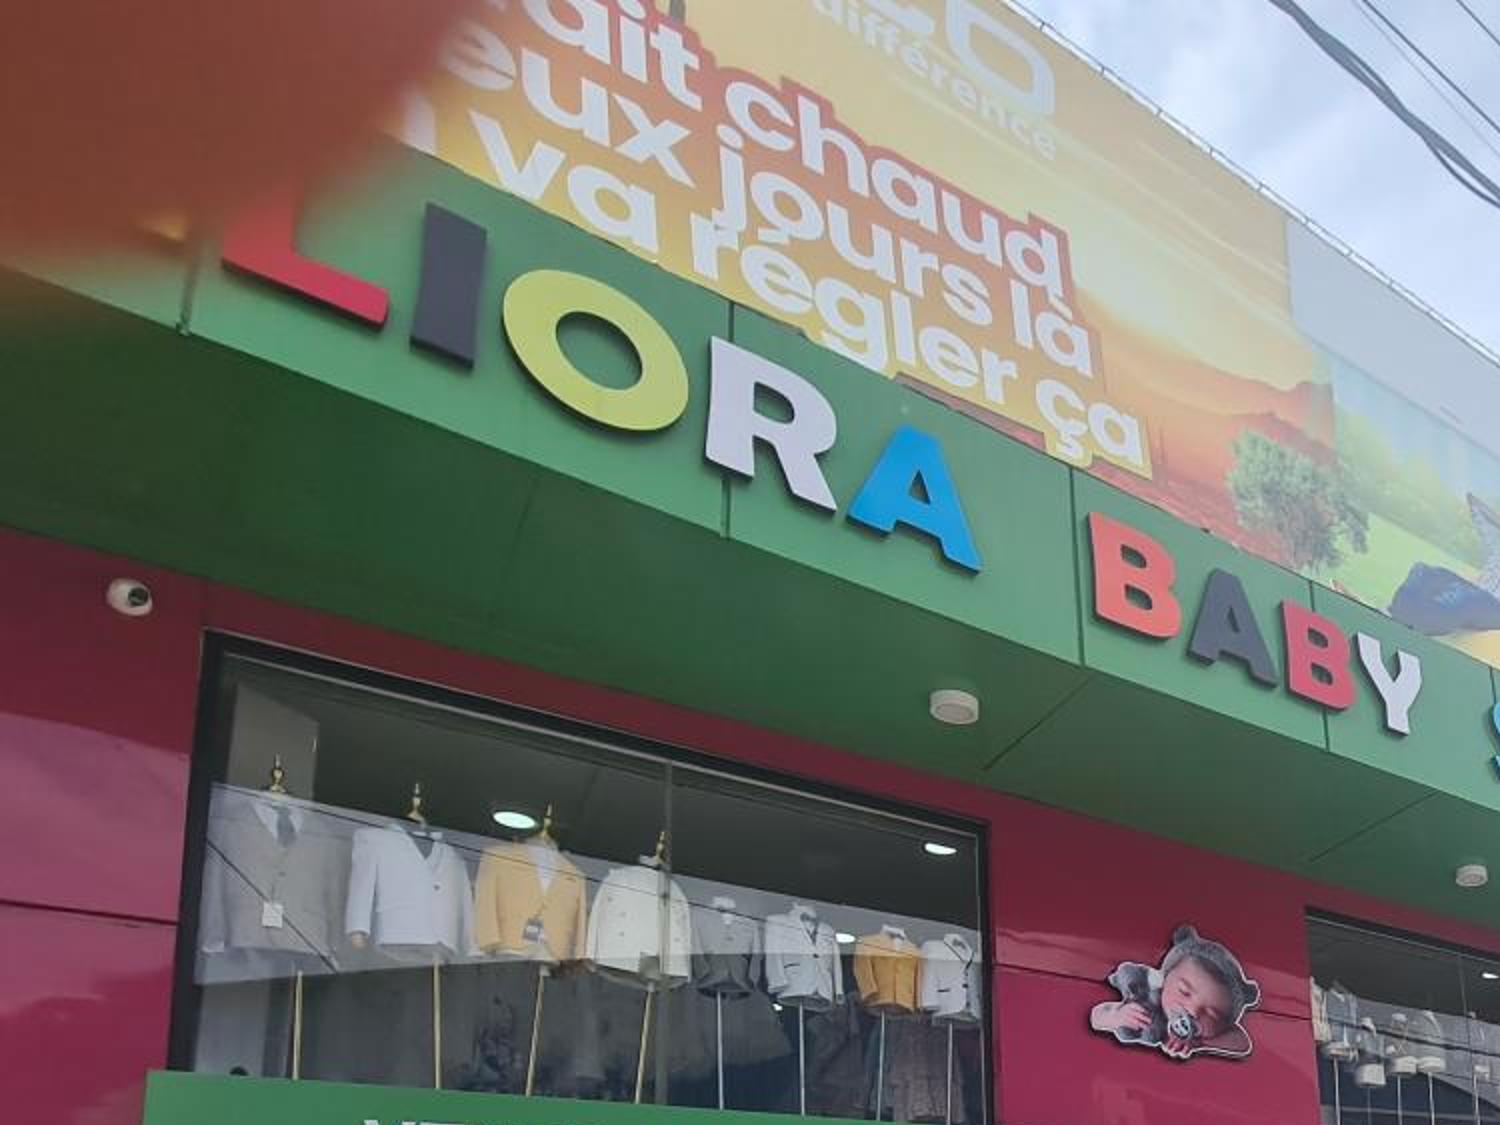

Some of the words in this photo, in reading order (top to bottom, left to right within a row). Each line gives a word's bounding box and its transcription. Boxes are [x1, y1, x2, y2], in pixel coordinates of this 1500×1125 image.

[440, 15, 696, 188] eux
[712, 123, 993, 325] jours
[1010, 278, 1093, 377] là
[469, 108, 659, 253] va
[690, 212, 1018, 405] régler
[1035, 378, 1144, 466] ça
[487, 0, 703, 112] ait
[725, 82, 1066, 298] chaud
[135, 180, 981, 575] LIORA
[1087, 511, 1423, 736] BABY
